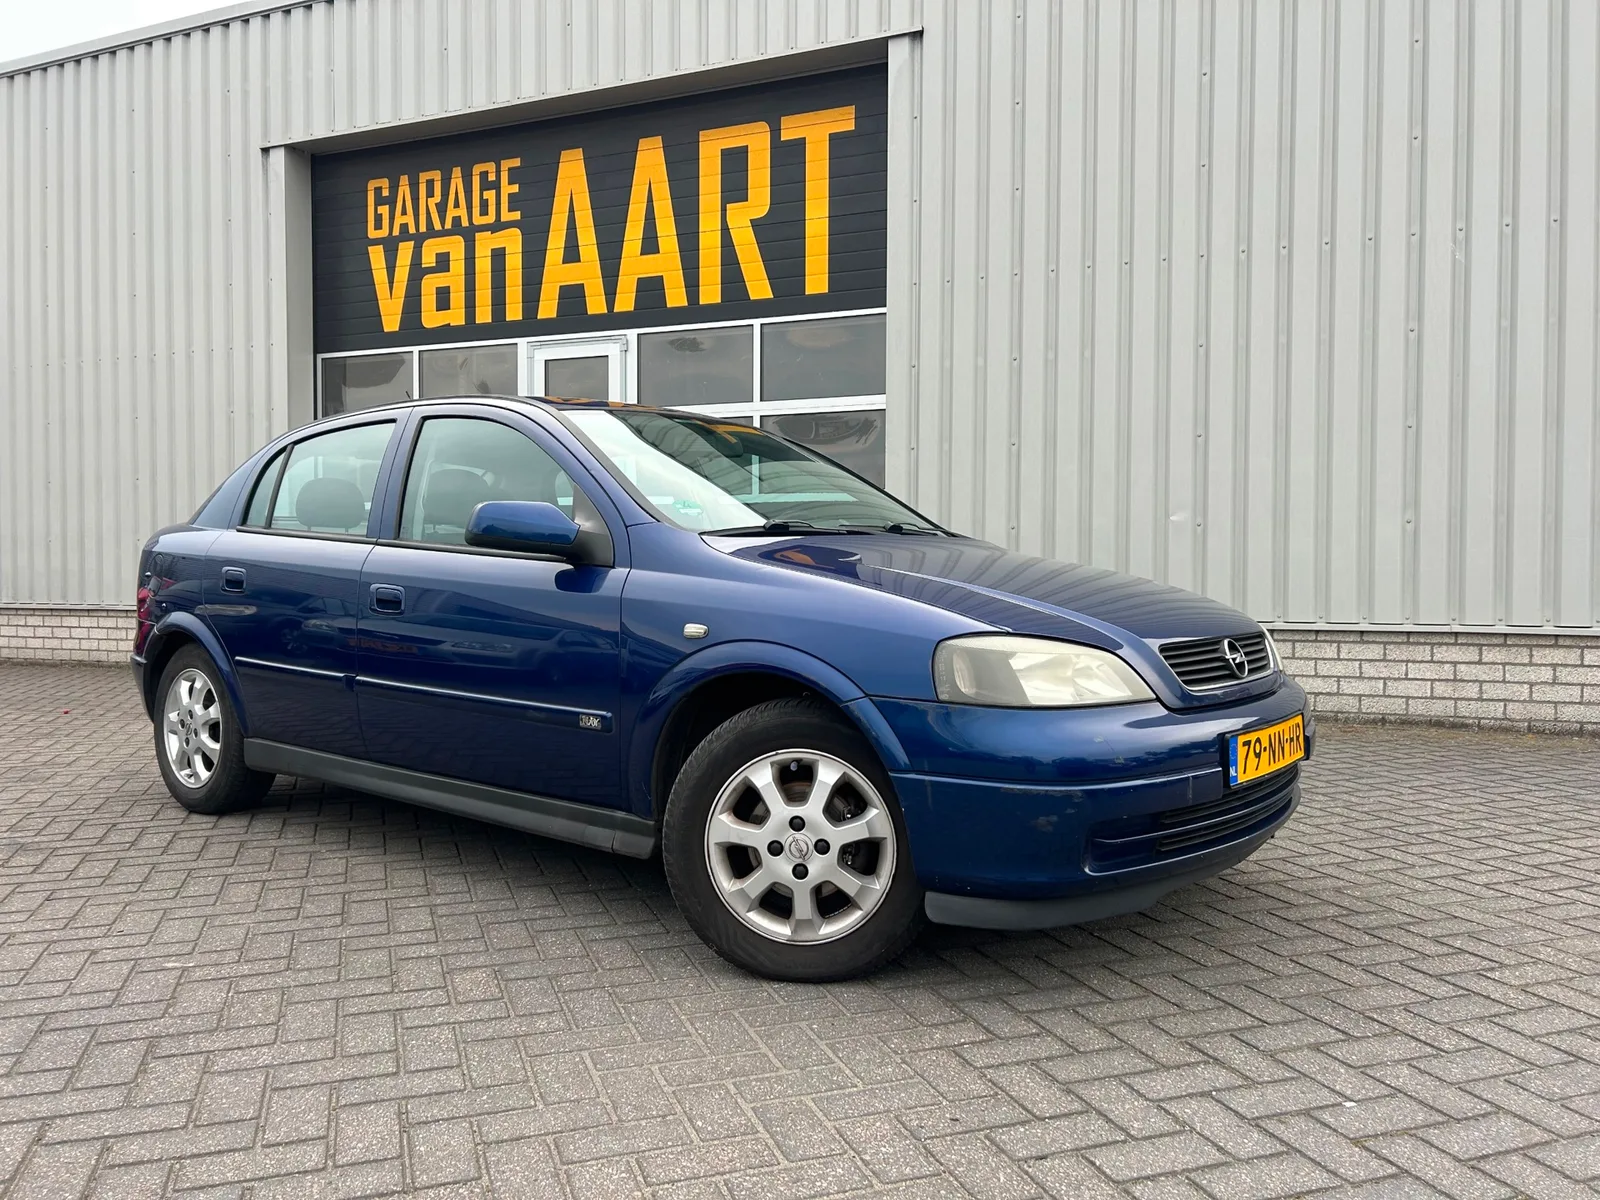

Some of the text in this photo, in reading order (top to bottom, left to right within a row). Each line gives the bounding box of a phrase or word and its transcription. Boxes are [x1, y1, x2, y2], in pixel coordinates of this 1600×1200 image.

[366, 156, 522, 239] GARAGE
[367, 105, 856, 333] van AART
[1229, 766, 1237, 777] NL
[1242, 722, 1302, 775] 79-NN-HR
